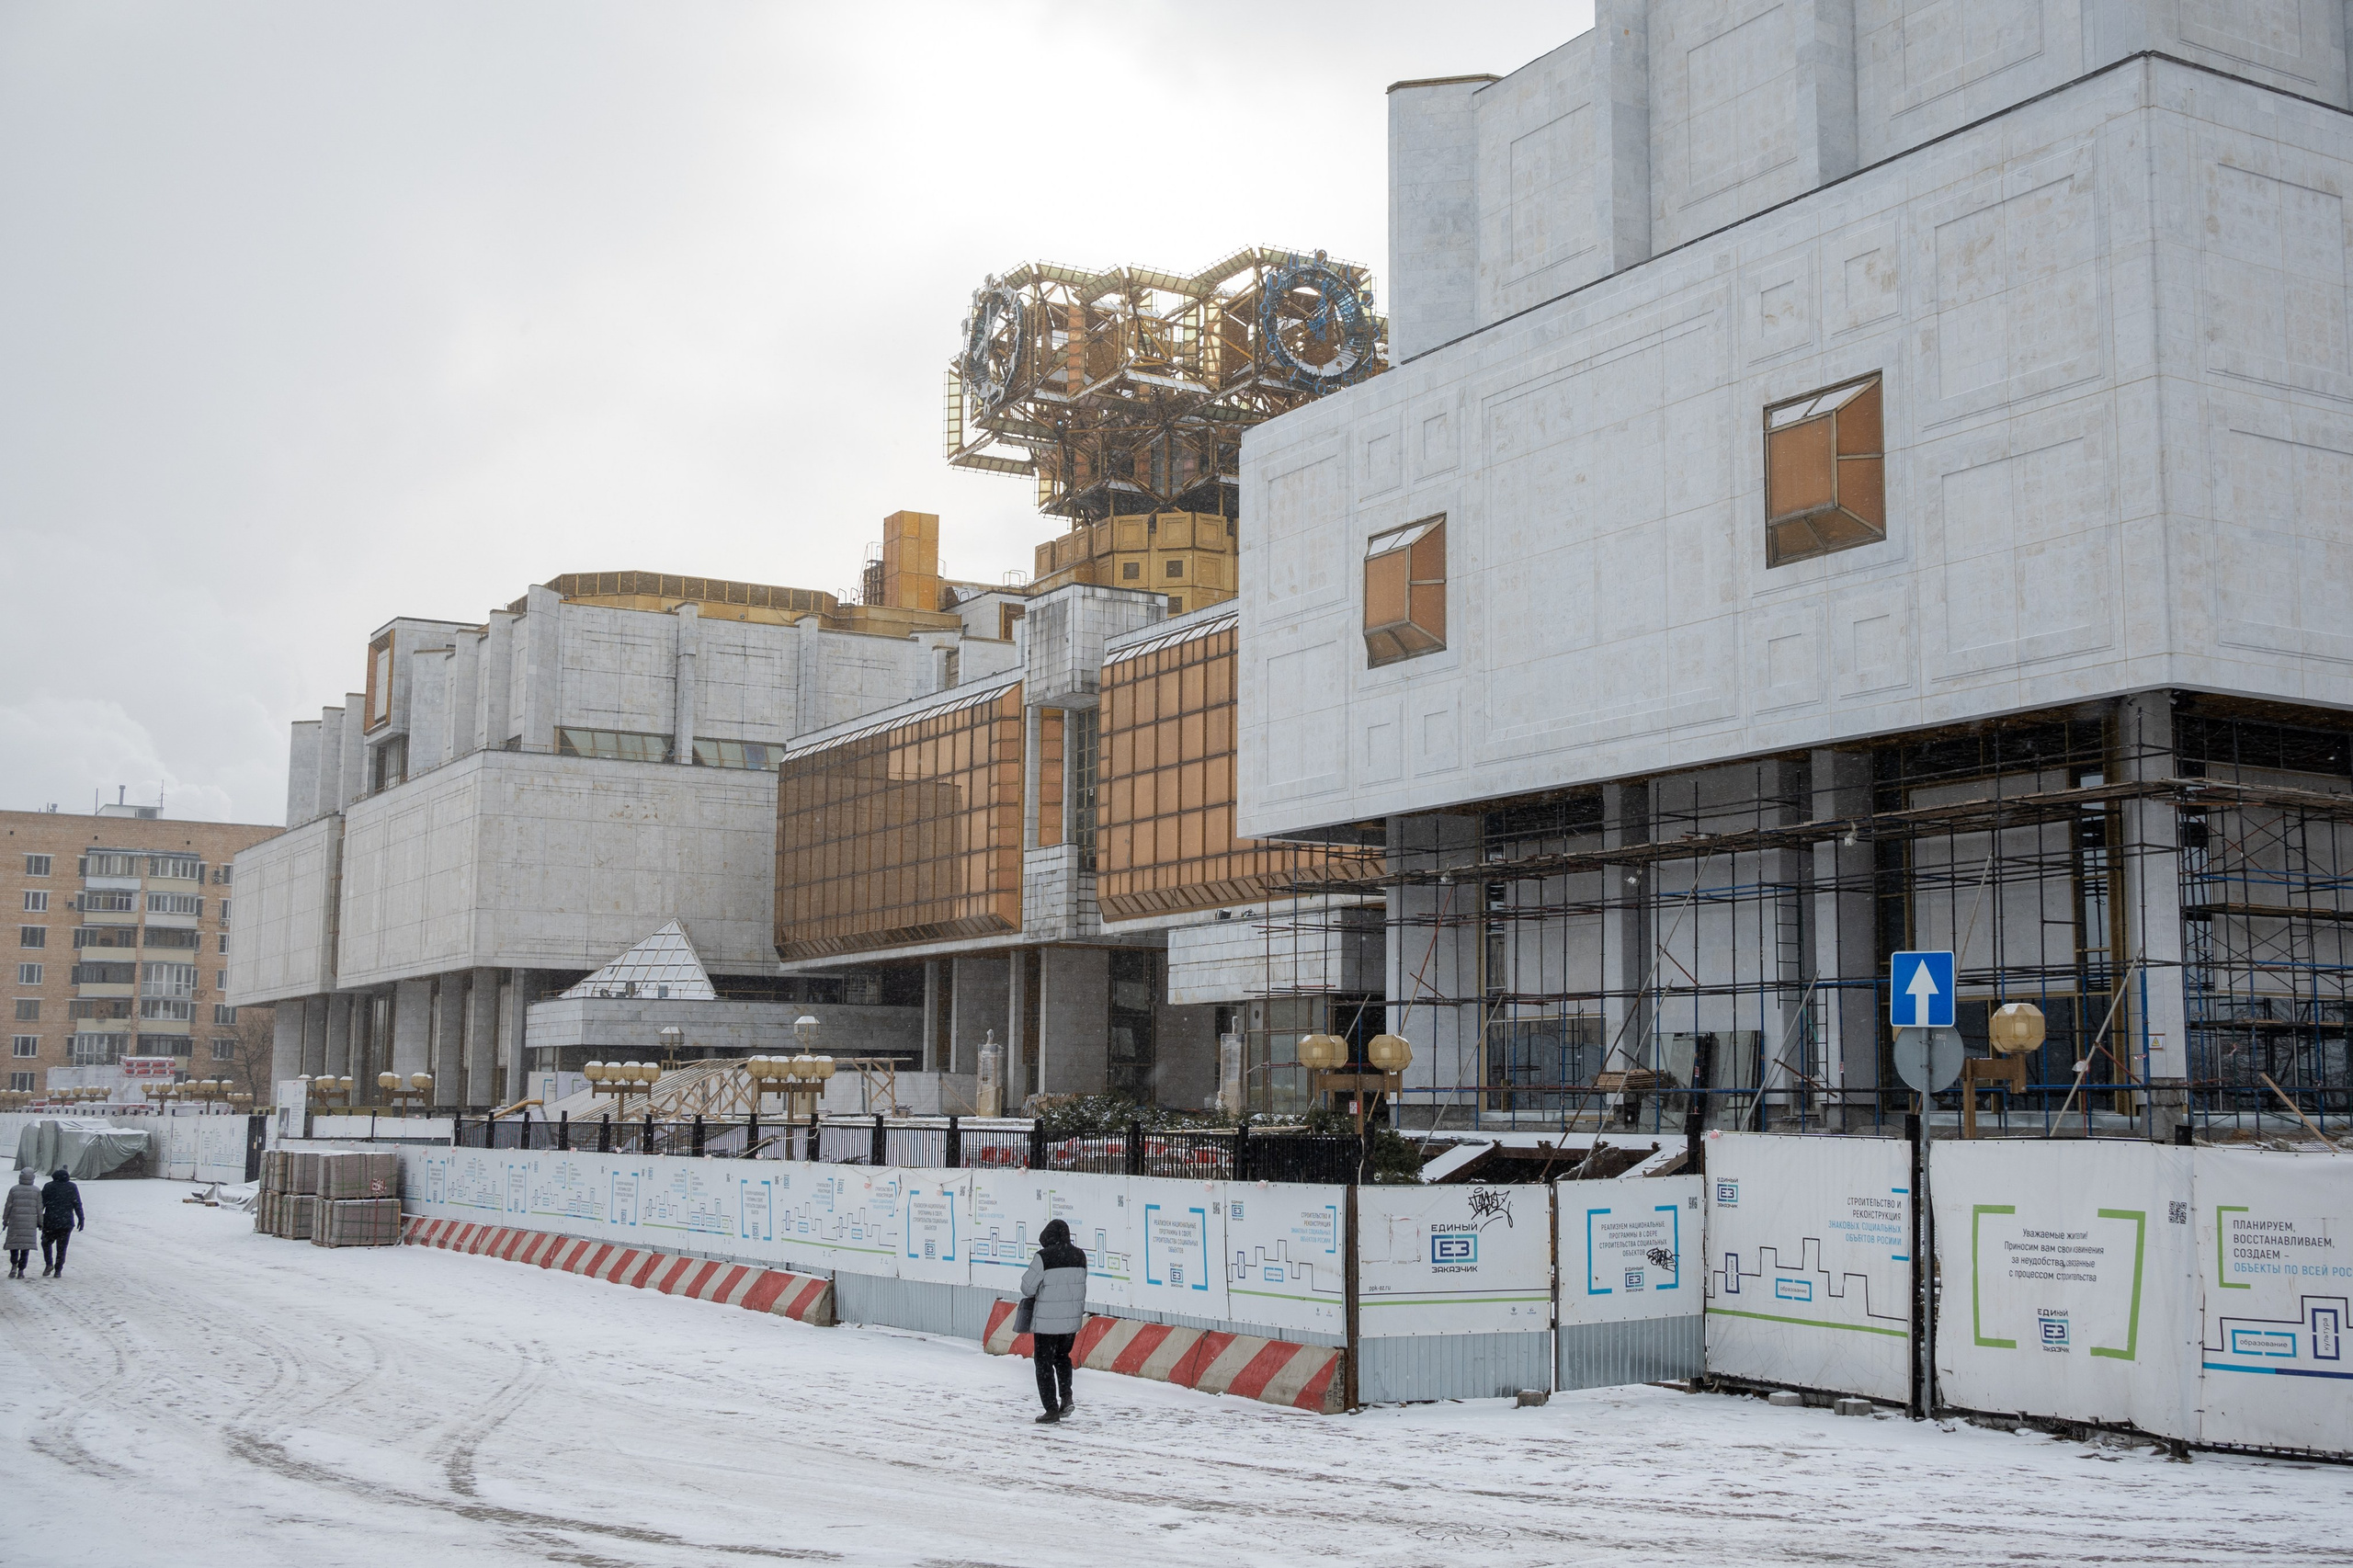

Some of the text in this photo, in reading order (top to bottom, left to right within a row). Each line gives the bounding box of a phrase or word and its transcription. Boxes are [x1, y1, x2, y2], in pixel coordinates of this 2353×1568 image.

[1847, 1197, 1902, 1209] СТРОИТЕЛЬСТВО И
[1852, 1210, 1902, 1221] РЕКОНСТРУКЦИЯ
[1431, 1221, 1478, 1233] ЕДИНЫЙ
[1601, 1221, 1665, 1231] РЕАЛИЗУЕМ НАЦИОНАЛЬНЫЕ
[1828, 1220, 1902, 1233] ЗНАКОВЫХ СОЦИАЛЬНЫХ
[2233, 1220, 2296, 1233] ПЛАНИРУЕМ,
[1845, 1233, 1875, 1244] ОБЪЕКТОВ
[2022, 1228, 2065, 1240] Уважаемые
[1599, 1239, 1667, 1249] СТРОИТЕЛЬСТВА СОЦИАЛЬНЫХ
[2233, 1233, 2335, 1248] ВОССТАНАВЛИВАЕМ,
[2004, 1241, 2039, 1252] Приносим
[2234, 1248, 2280, 1259] СОЗДАЕМ
[2021, 1256, 2066, 1268] неудобства,
[1431, 1265, 1478, 1273] ЗАКАЗЧИК
[2009, 1269, 2013, 1278] с
[2015, 1270, 2054, 1279] процессом
[2234, 1262, 2280, 1274] ОБЪЕКТЫ
[2284, 1265, 2298, 1275] ПО
[2302, 1264, 2328, 1276] ВСЕЙ
[2239, 1339, 2288, 1348] образование
